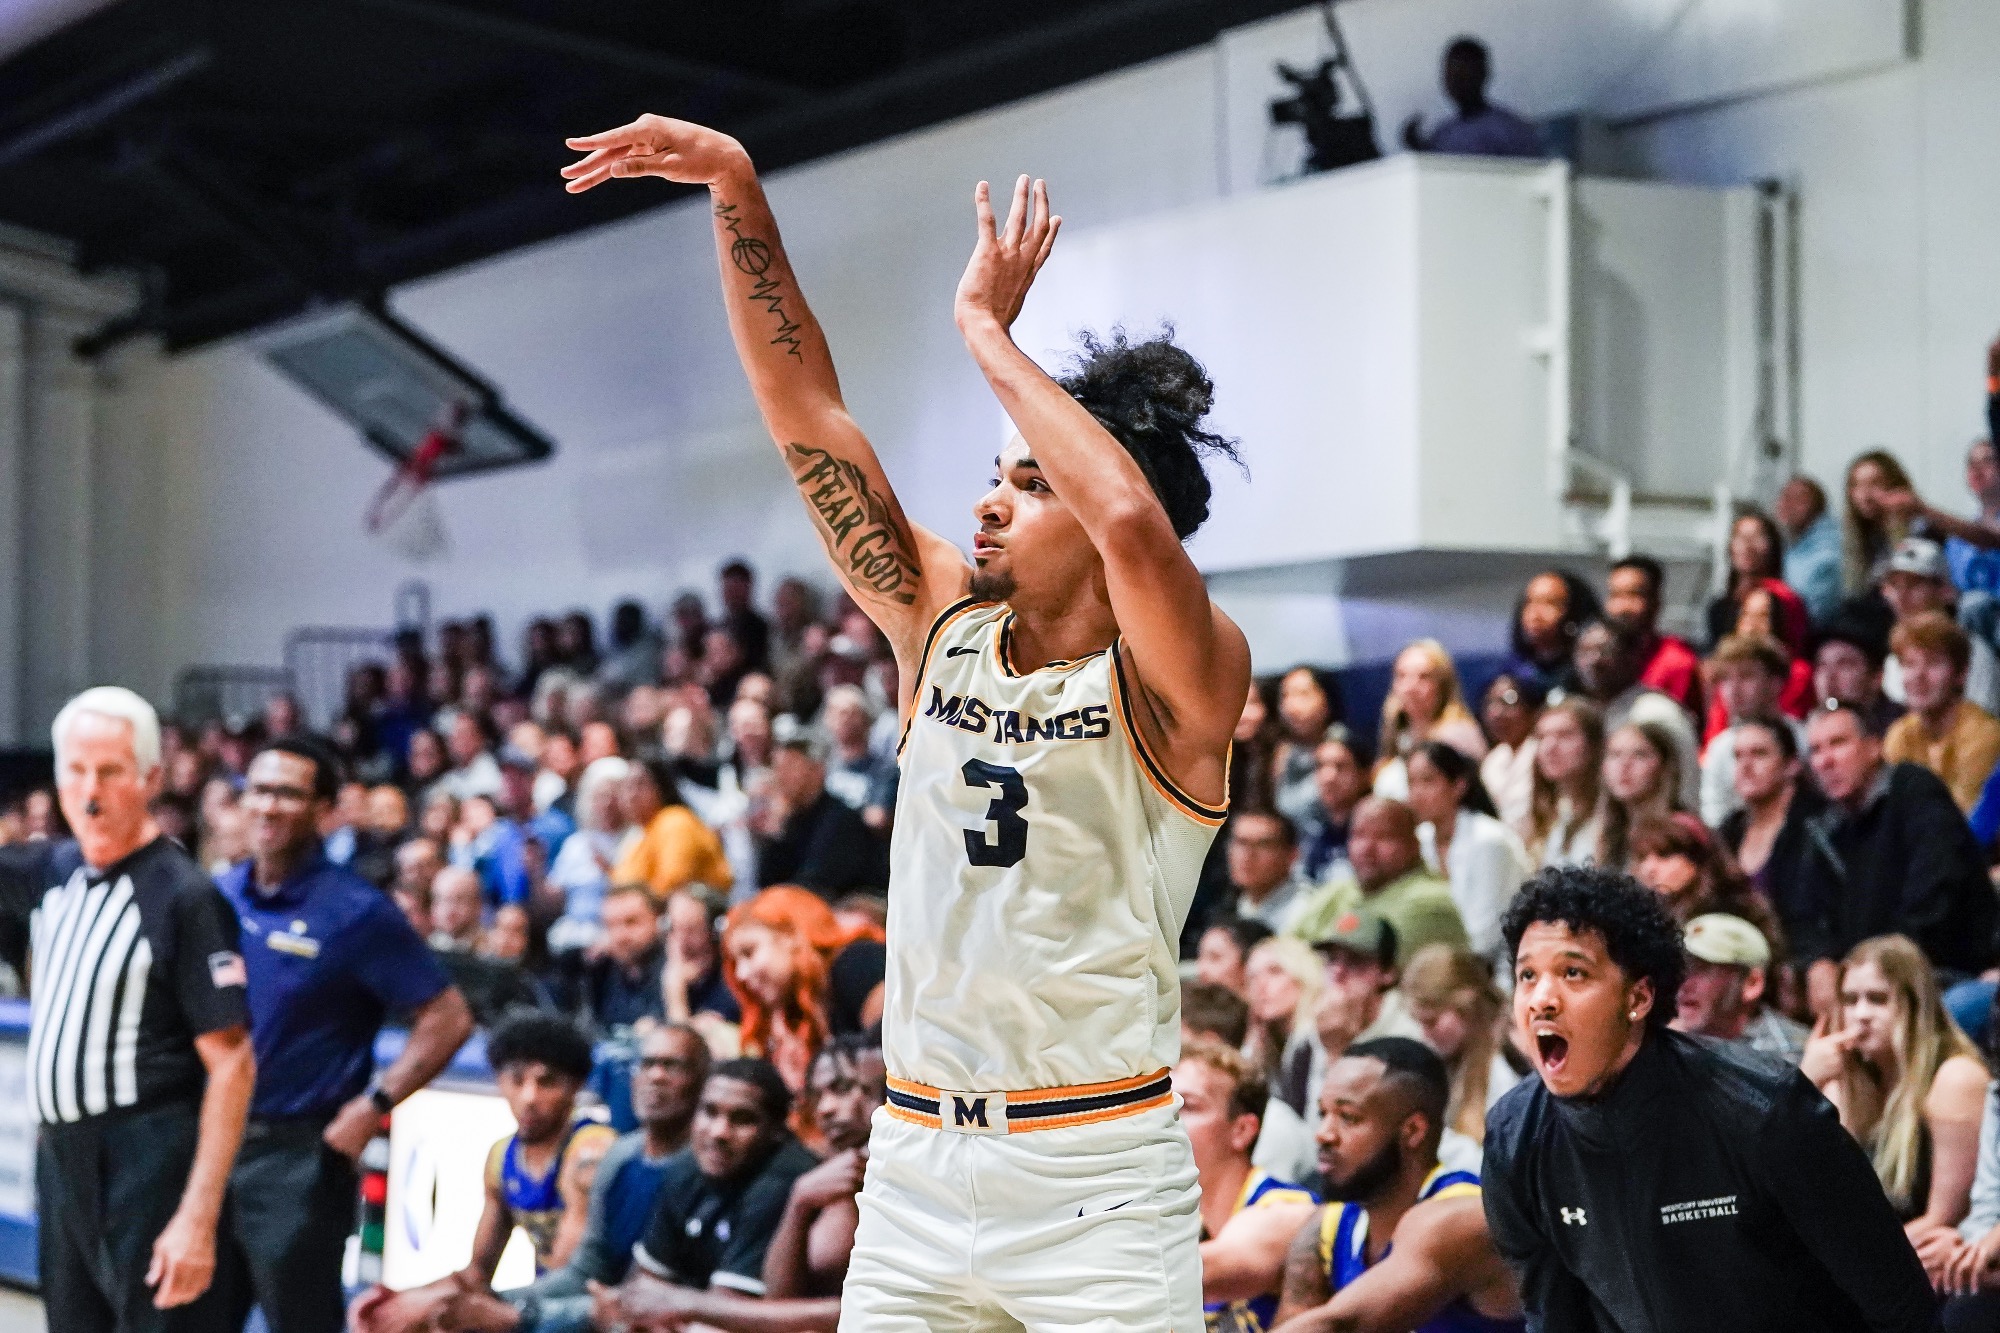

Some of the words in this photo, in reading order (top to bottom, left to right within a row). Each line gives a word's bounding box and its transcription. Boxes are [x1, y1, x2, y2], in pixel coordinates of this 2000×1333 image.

[797, 450, 865, 549] FEAR
[924, 683, 1112, 745] MUSTANGS
[961, 757, 1029, 868] 3
[951, 1095, 991, 1128] M
[1661, 1204, 1739, 1225] BASKETBALL
